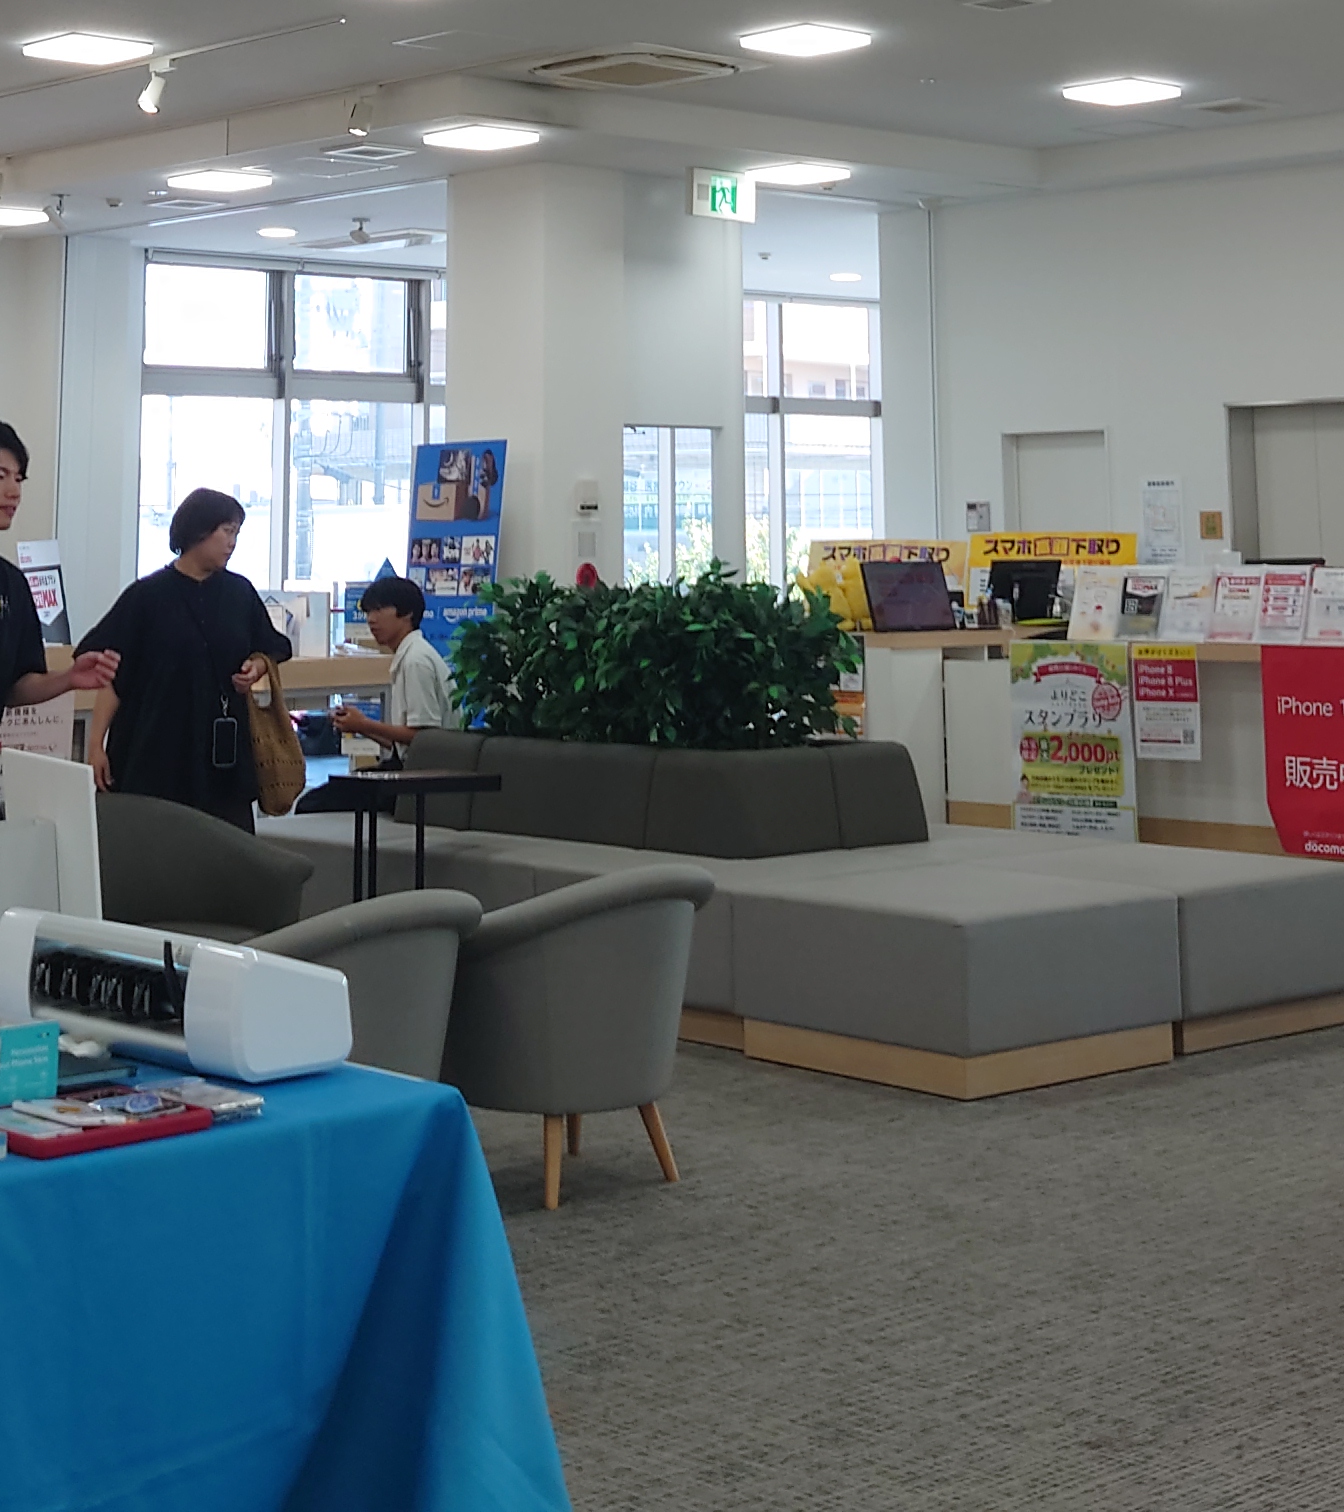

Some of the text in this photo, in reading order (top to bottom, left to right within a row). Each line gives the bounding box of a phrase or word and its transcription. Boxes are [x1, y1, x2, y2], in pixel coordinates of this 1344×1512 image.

[983, 538, 1121, 555] スマホ 下取り
[1277, 696, 1334, 717] iPhone
[1024, 708, 1117, 728] スタンプラリー
